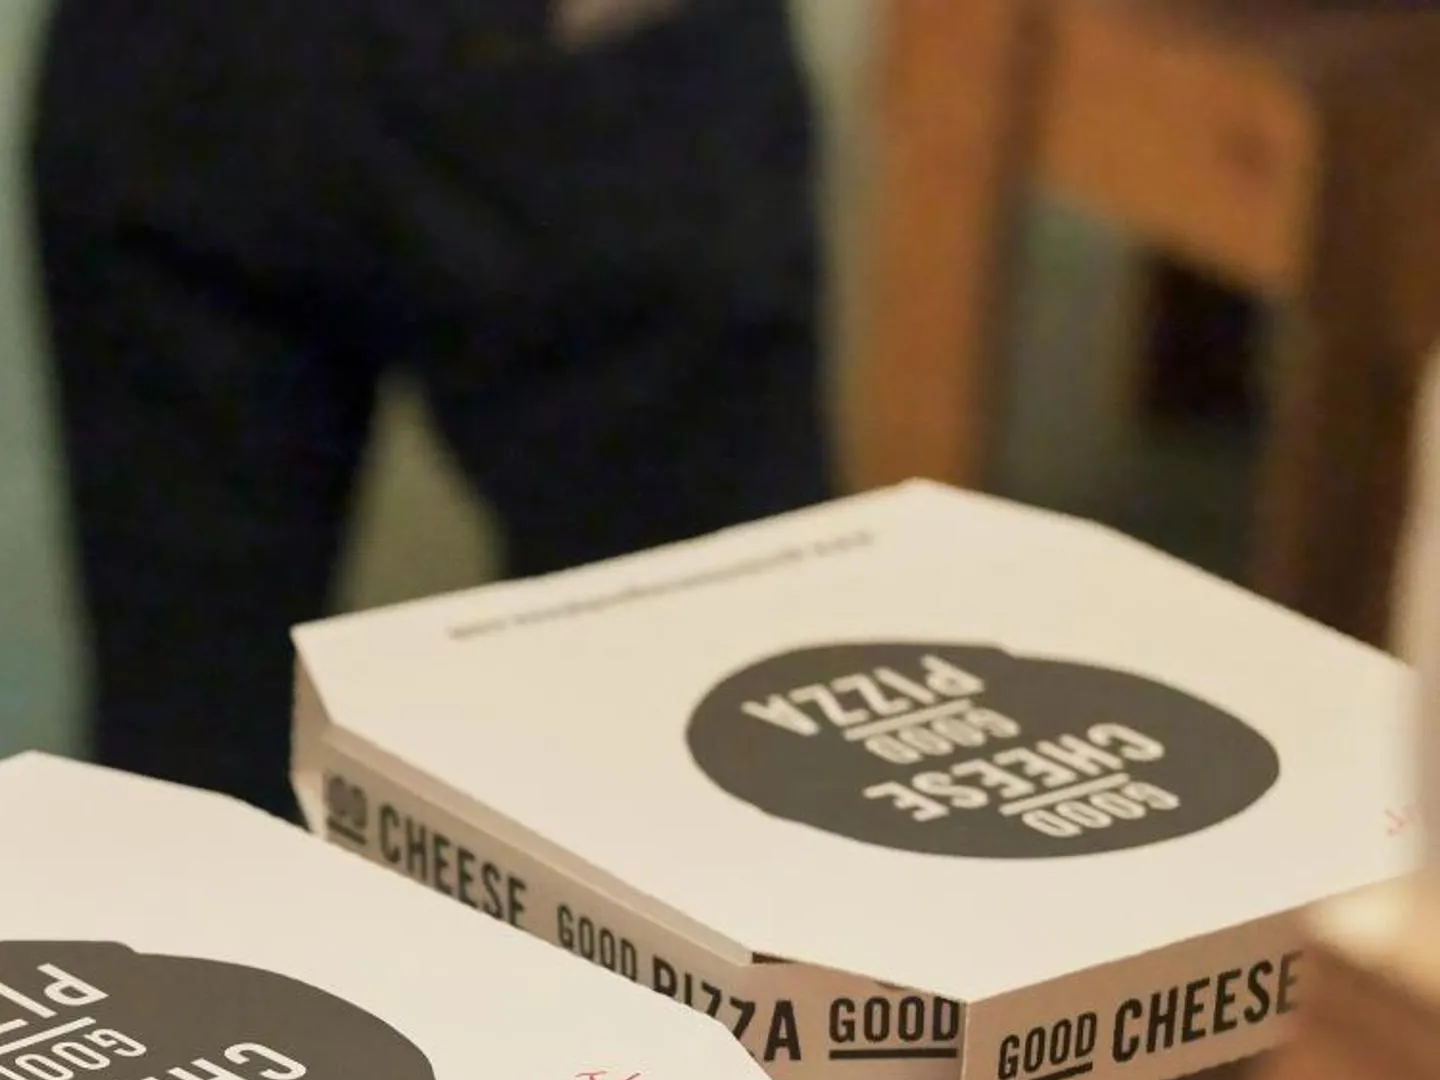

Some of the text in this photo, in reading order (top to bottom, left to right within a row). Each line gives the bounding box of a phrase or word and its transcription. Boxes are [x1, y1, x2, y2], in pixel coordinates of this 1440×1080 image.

[740, 653, 986, 737] PIZZA
[865, 706, 1022, 765] GOOD
[863, 722, 1166, 822] CHEESE
[1021, 781, 1181, 838] GOOD
[379, 805, 528, 928] CHEESE
[557, 903, 637, 983] GOOD
[828, 996, 959, 1044] GOOD
[1111, 949, 1304, 1064] CHEESE
